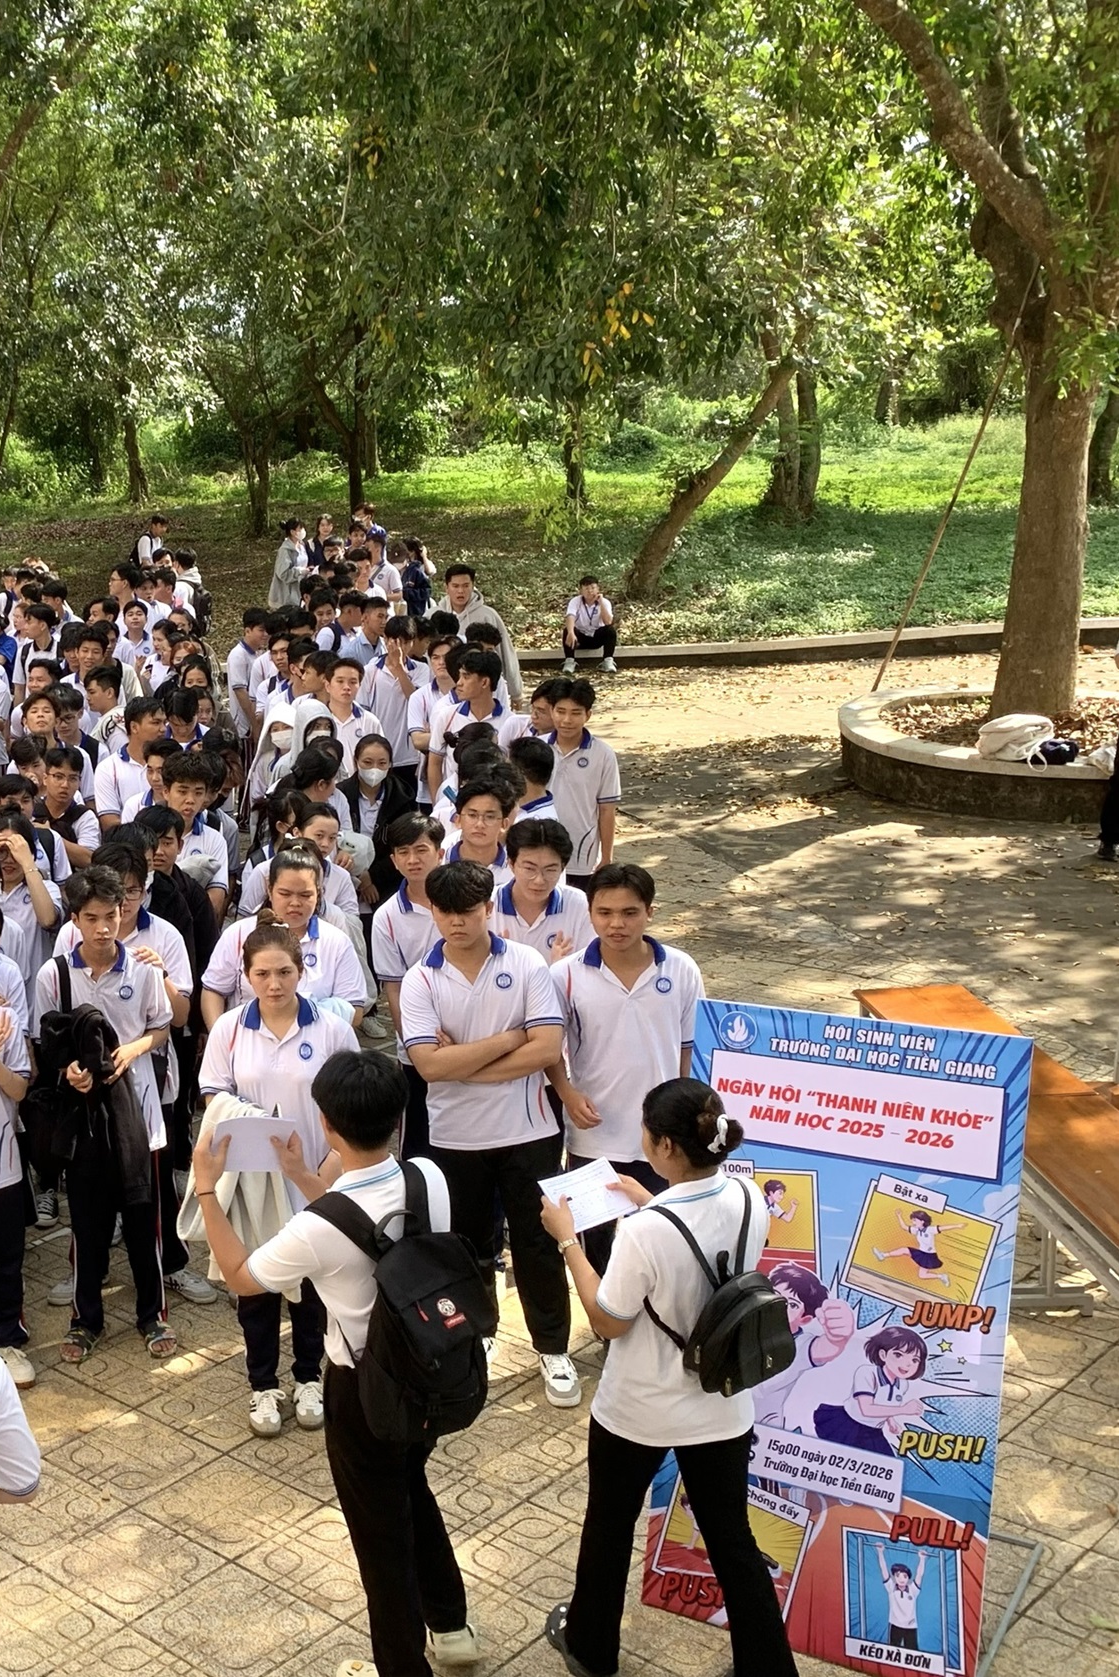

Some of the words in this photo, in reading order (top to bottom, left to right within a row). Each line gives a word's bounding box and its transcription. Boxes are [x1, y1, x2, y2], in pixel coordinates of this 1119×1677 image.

[824, 1024, 852, 1042] HỘI
[856, 1029, 895, 1047] SINH
[900, 1034, 936, 1052] VIÊN
[770, 1038, 831, 1058] TRƯỜNG
[835, 1046, 862, 1064] ĐẠI
[866, 1051, 900, 1068] HỌC
[905, 1052, 940, 1072] TIỀN
[945, 1060, 997, 1080] GIANG
[717, 1078, 765, 1097] NGÀY
[769, 1084, 801, 1104] HỘI
[882, 1101, 925, 1121] NIÊN
[749, 1104, 791, 1124] NĂM
[794, 1112, 834, 1130] HỌC
[837, 1119, 885, 1138] 2025
[905, 1129, 954, 1148] 2026
[722, 1164, 751, 1173] 100m
[893, 1184, 913, 1197] Bật
[915, 1192, 928, 1203] xa
[903, 1300, 996, 1334] JUMP!
[898, 1430, 987, 1464] PUSH!
[763, 1456, 799, 1477] Trường
[800, 1466, 819, 1482] Đại
[819, 1471, 838, 1486] học
[863, 1483, 895, 1503] Giang
[801, 1450, 827, 1465] ngày
[828, 1454, 893, 1480] 02/3/2026
[747, 1489, 777, 1510] hống
[890, 1515, 975, 1550] PULL!
[859, 1644, 884, 1659] KÉO
[885, 1648, 902, 1663] XÀ
[905, 1653, 931, 1669] ĐƠN
